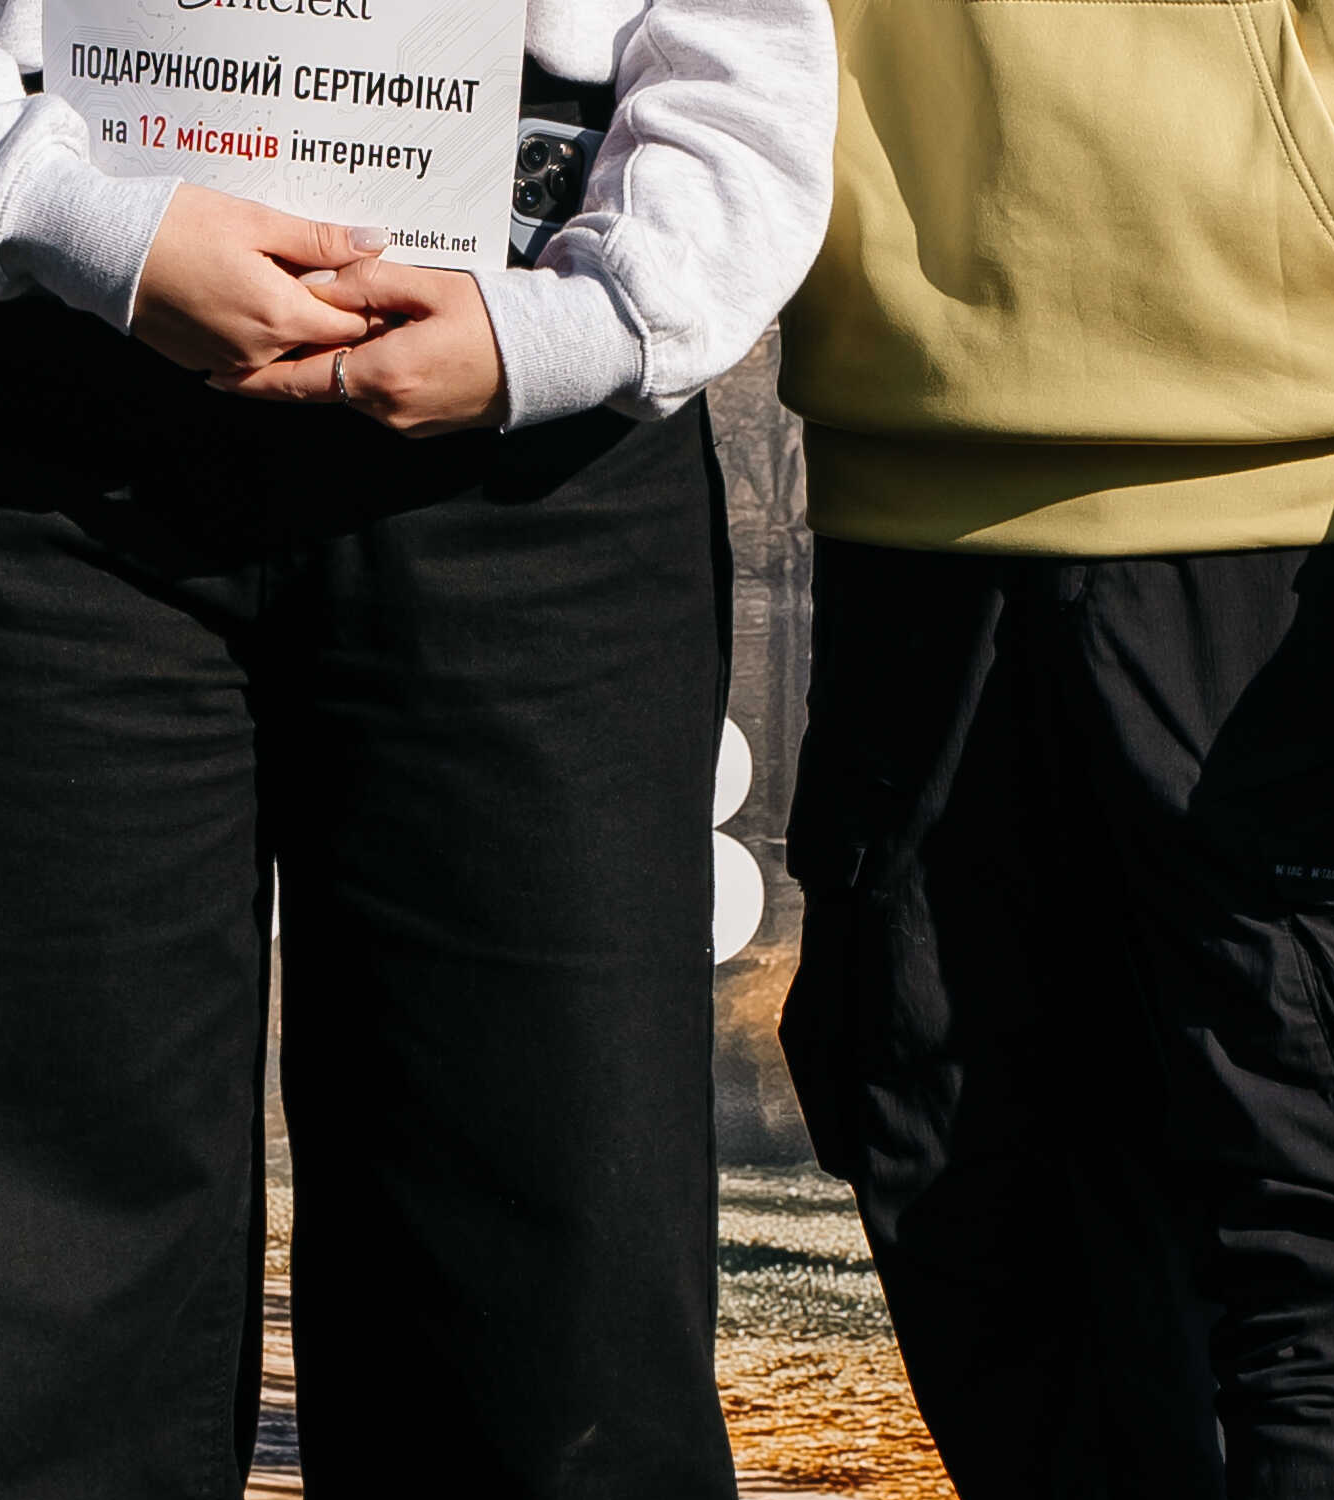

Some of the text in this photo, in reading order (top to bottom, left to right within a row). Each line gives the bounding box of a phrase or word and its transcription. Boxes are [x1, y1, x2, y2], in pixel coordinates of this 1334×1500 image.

[70, 42, 481, 114] ПОДАРУНКОВИЙ СЕРТИФІКАТ
[101, 114, 434, 181] на 12 місяців інтернету
[385, 226, 477, 253] ntelekt.net
